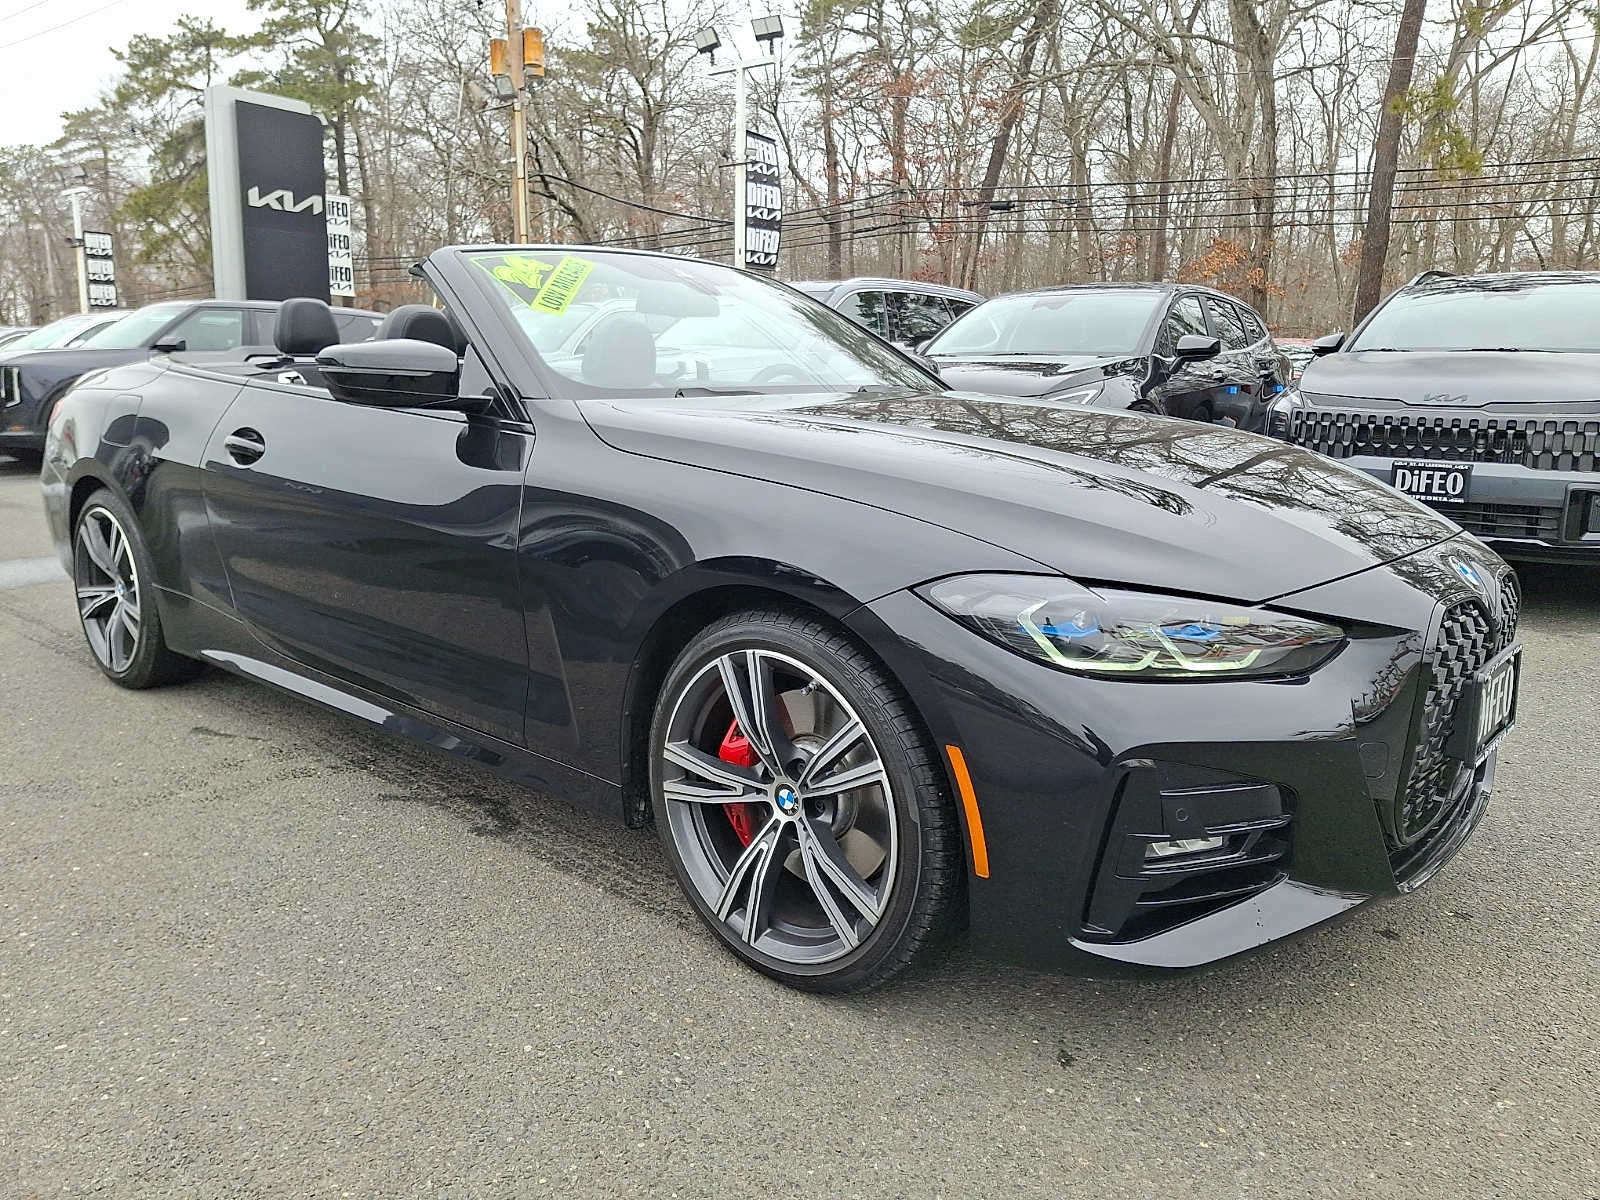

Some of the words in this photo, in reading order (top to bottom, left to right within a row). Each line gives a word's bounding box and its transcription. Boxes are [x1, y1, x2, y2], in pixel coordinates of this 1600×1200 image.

[747, 162, 779, 177] KIA
[247, 186, 323, 215] KIA
[327, 201, 348, 217] iFEO
[747, 207, 782, 221] KIA
[329, 234, 350, 250] iFEO
[746, 251, 778, 266] KIA
[331, 266, 352, 282] iFEO
[538, 290, 568, 311] LOW
[1424, 391, 1468, 402] KIA
[1394, 468, 1464, 496] DiFEO
